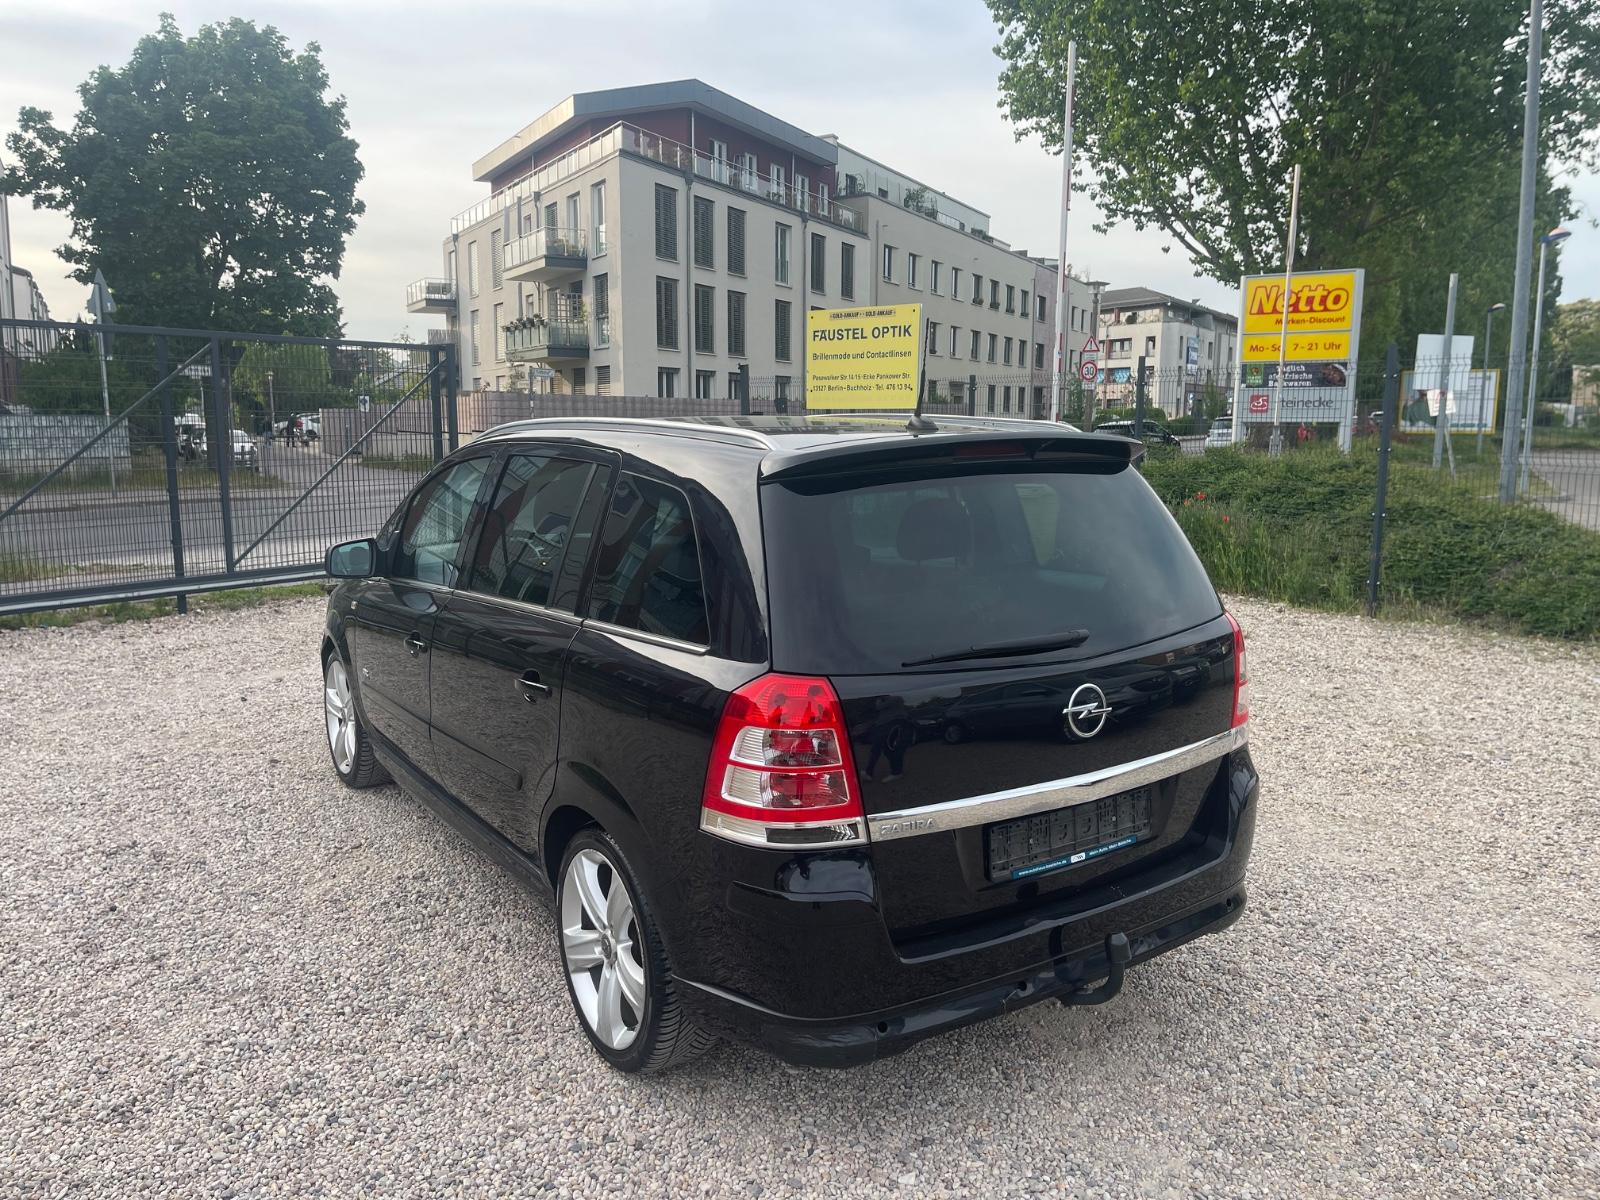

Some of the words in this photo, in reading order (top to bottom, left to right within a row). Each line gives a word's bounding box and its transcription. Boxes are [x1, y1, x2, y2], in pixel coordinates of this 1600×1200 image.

[1249, 284, 1349, 315] Netto
[1275, 316, 1345, 325] Mrken-Discount
[813, 327, 867, 341] FÄUSTEL
[871, 325, 912, 339] OPTIK
[1323, 341, 1342, 350] Uhr
[812, 352, 851, 360] Brillenmode
[852, 351, 865, 359] und
[866, 350, 912, 359] Contactlinsen
[1085, 366, 1094, 375] 30
[1276, 364, 1305, 372] Tglich
[1280, 397, 1334, 408] teinecke
[881, 818, 936, 834] ZAFIRA
